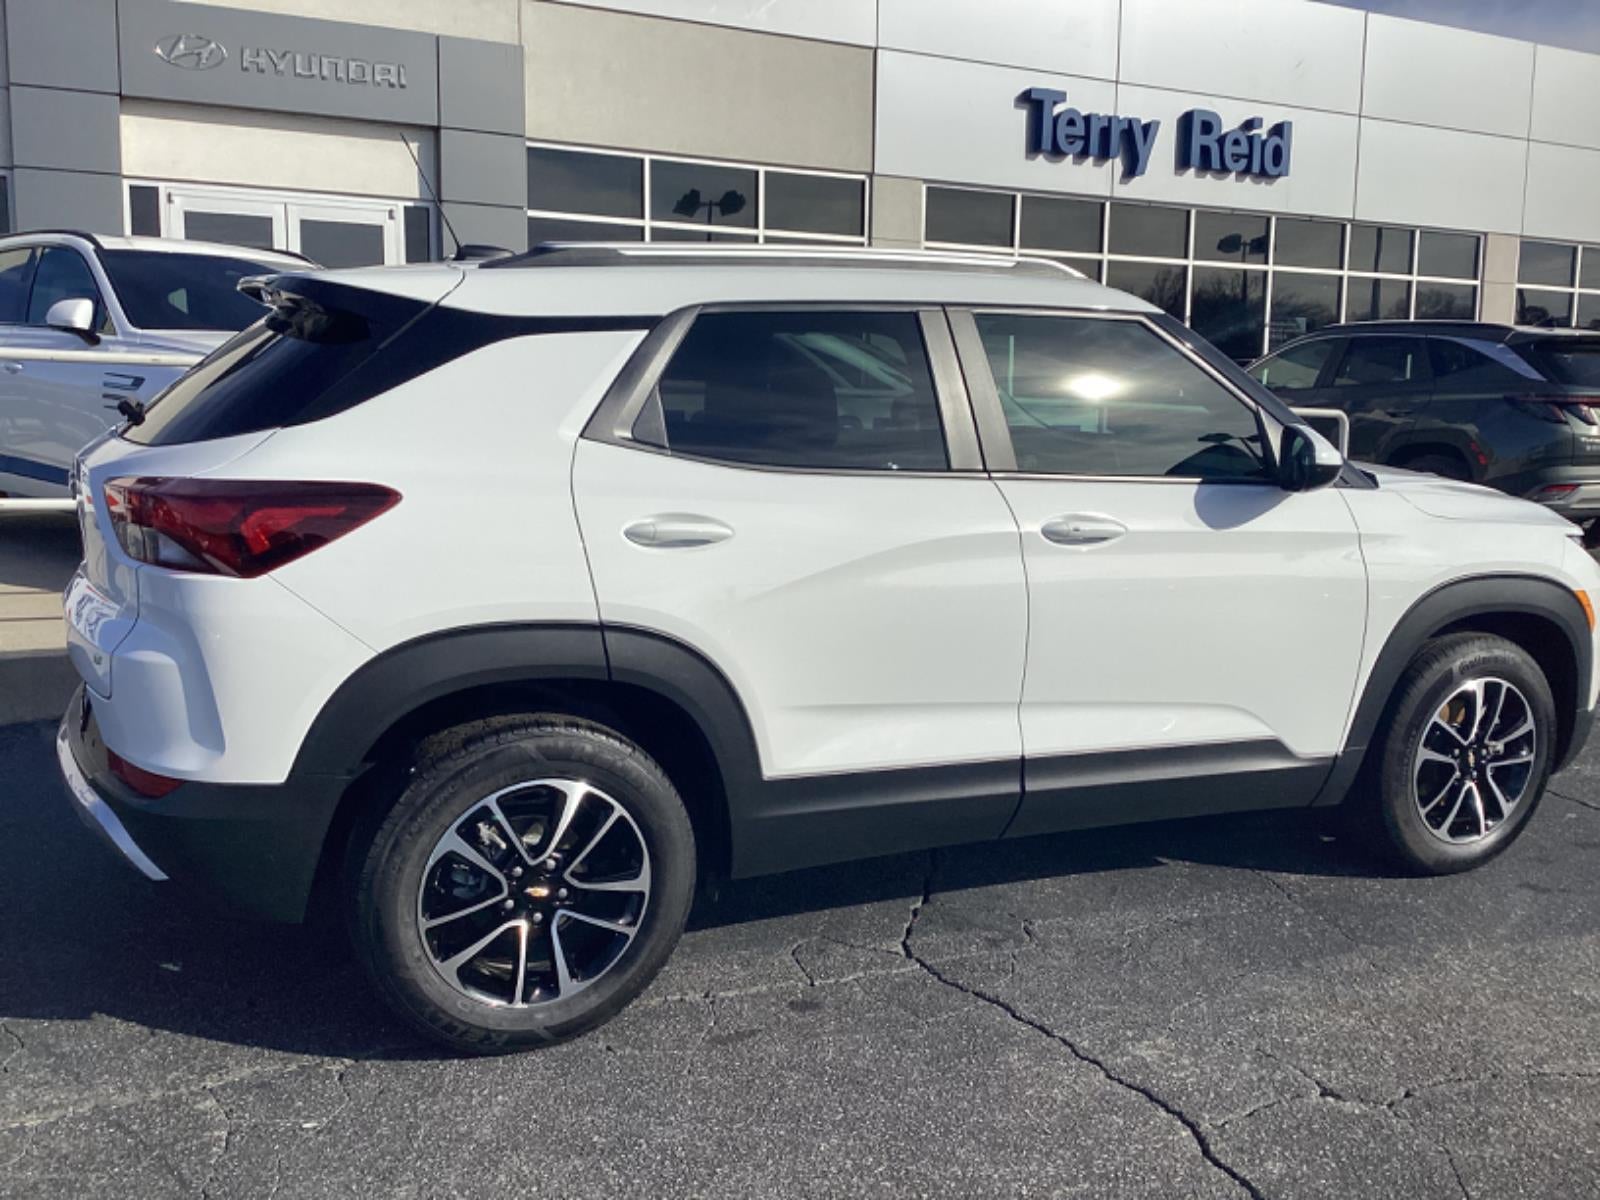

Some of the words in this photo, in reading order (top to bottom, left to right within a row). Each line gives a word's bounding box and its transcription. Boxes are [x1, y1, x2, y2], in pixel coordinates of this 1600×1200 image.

[240, 46, 407, 88] HYUNDAI
[1015, 87, 1160, 179] Terry
[1175, 108, 1293, 178] Reid
